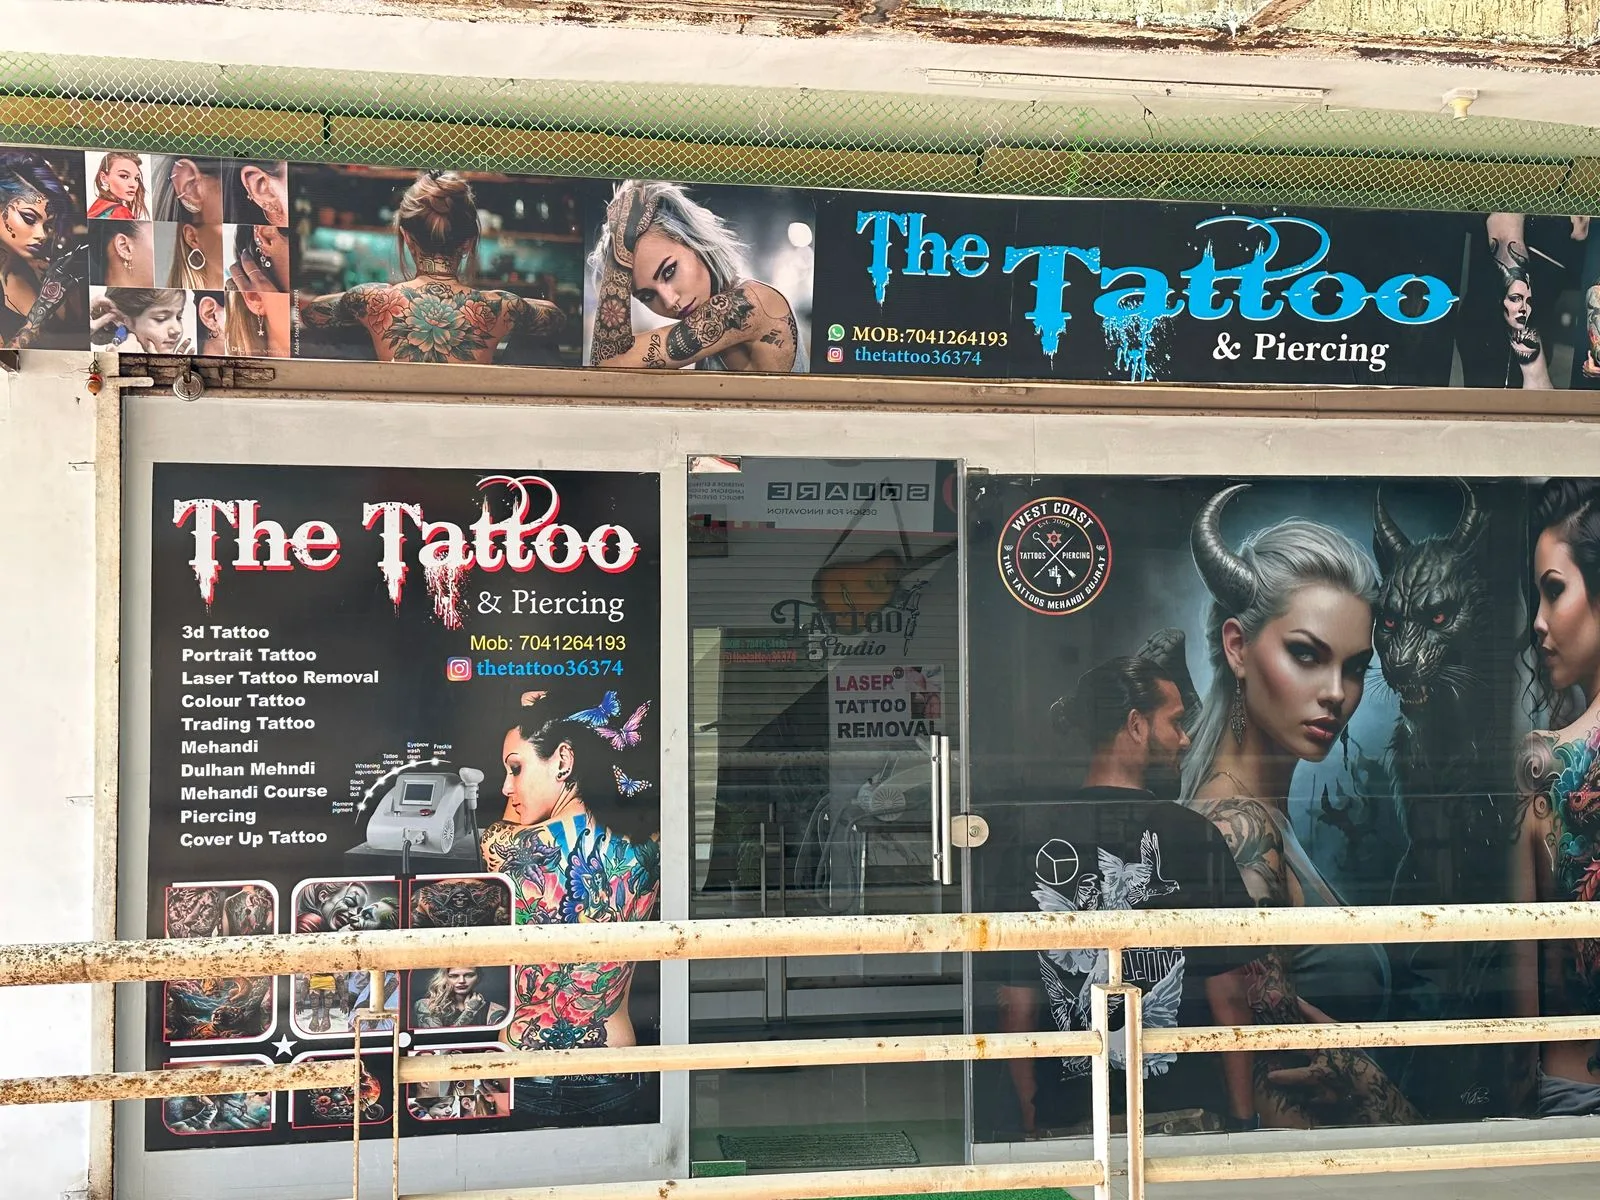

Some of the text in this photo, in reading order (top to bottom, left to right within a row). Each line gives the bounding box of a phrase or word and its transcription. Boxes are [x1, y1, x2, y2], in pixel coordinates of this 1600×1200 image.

[856, 210, 1460, 381] The Tattoo
[851, 326, 1008, 347] MOB:7041264193
[855, 346, 982, 366] thetattoo36374
[1213, 332, 1389, 372] & Piercing
[1011, 502, 1094, 532] WEST COAST
[173, 475, 641, 630] The Tattoo
[1019, 551, 1046, 560] TATTOOS
[1062, 551, 1090, 560] PIERCING
[1002, 554, 1015, 576] THE
[1011, 577, 1045, 608] TATTOOS
[1047, 592, 1085, 610] MEHANDI
[477, 590, 624, 622] & Piercing
[182, 625, 270, 639] 3d Tattoo
[470, 635, 626, 651] Mob: 7041264193
[182, 648, 317, 662] Portrait Tattoo
[477, 659, 624, 677] thetattoo36374
[182, 670, 379, 685] Laser Tattoo Removal
[836, 674, 895, 692] LASER
[182, 694, 306, 708] Colour Tattoo
[835, 698, 907, 714] TATTOO
[181, 716, 316, 734] Trading Tattoo
[837, 720, 942, 739] REMOVAL
[181, 740, 259, 754] Mehandi
[181, 761, 316, 777] Dulhan Mehndi
[181, 784, 328, 800] Mehandi Course
[181, 808, 257, 826] Piercing
[180, 830, 328, 848] Cover Up Tattoo
